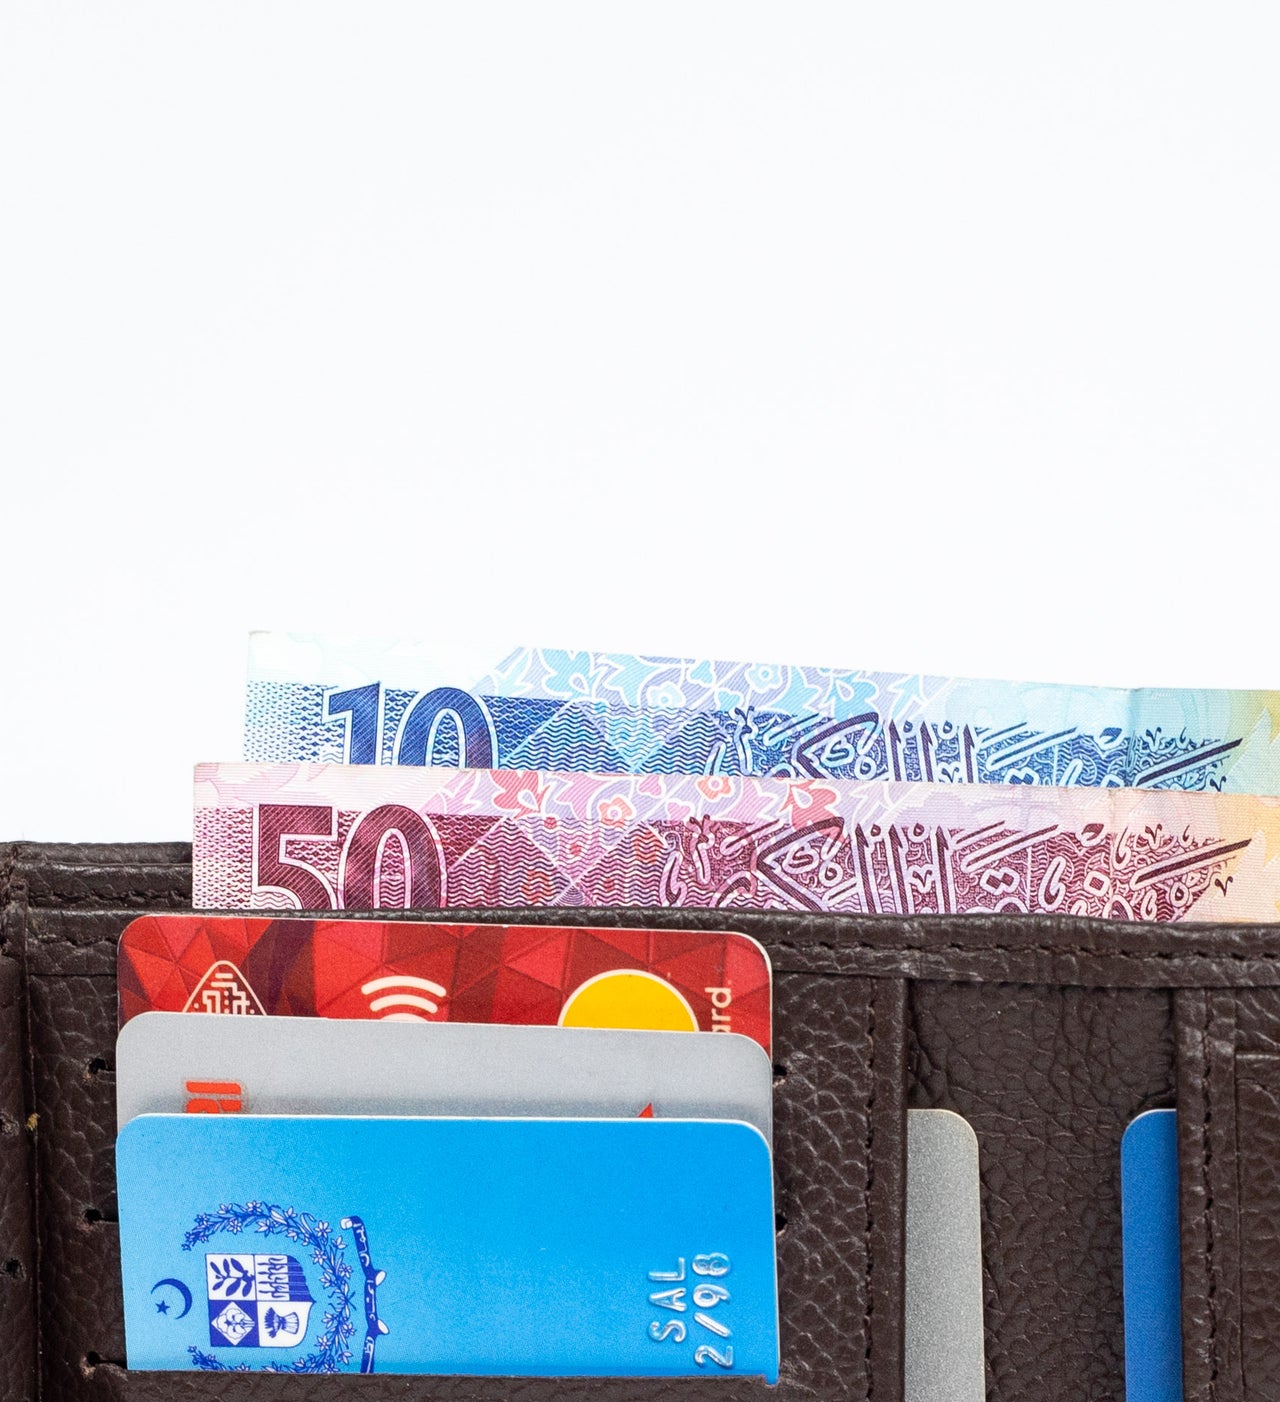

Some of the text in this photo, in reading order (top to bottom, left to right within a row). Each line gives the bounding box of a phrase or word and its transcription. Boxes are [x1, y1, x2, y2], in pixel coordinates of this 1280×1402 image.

[256, 804, 445, 908] 50
[647, 1256, 687, 1343] SAL
[692, 1252, 734, 1369] 2/98
